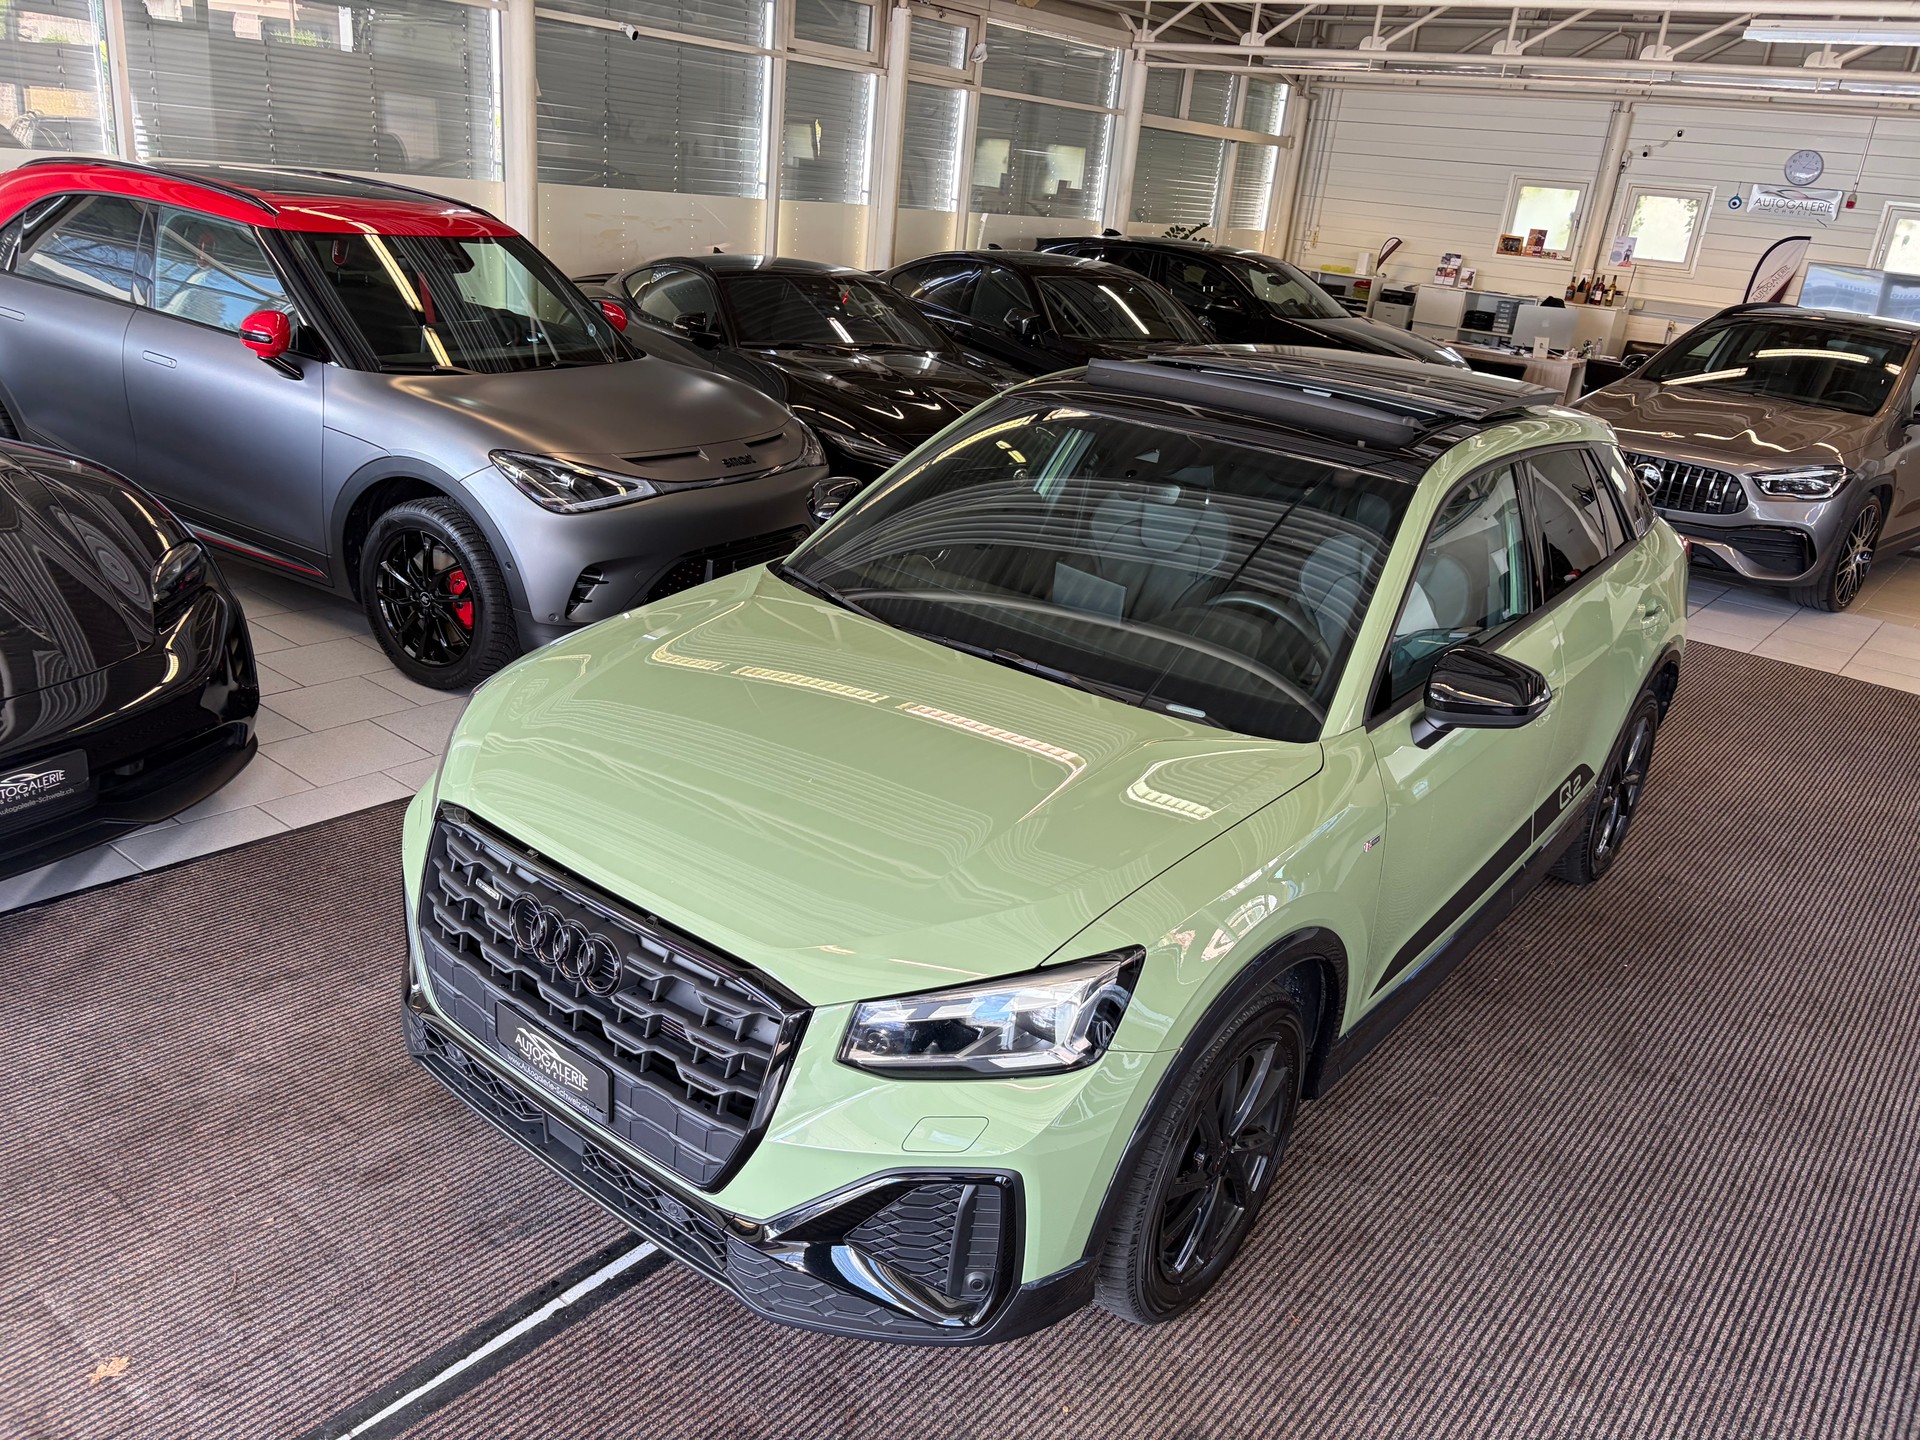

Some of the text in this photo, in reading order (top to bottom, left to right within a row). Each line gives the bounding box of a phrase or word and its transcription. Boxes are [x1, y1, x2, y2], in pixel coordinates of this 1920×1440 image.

[1754, 197, 1834, 213] AUTOGALERIE
[1753, 265, 1791, 302] AUTOGALERIE
[0, 771, 66, 799] TOGALERIE
[1559, 774, 1581, 810] Q2
[515, 1033, 589, 1091] AUTOGALERIE
[528, 1055, 569, 1086] SCHWEIZ
